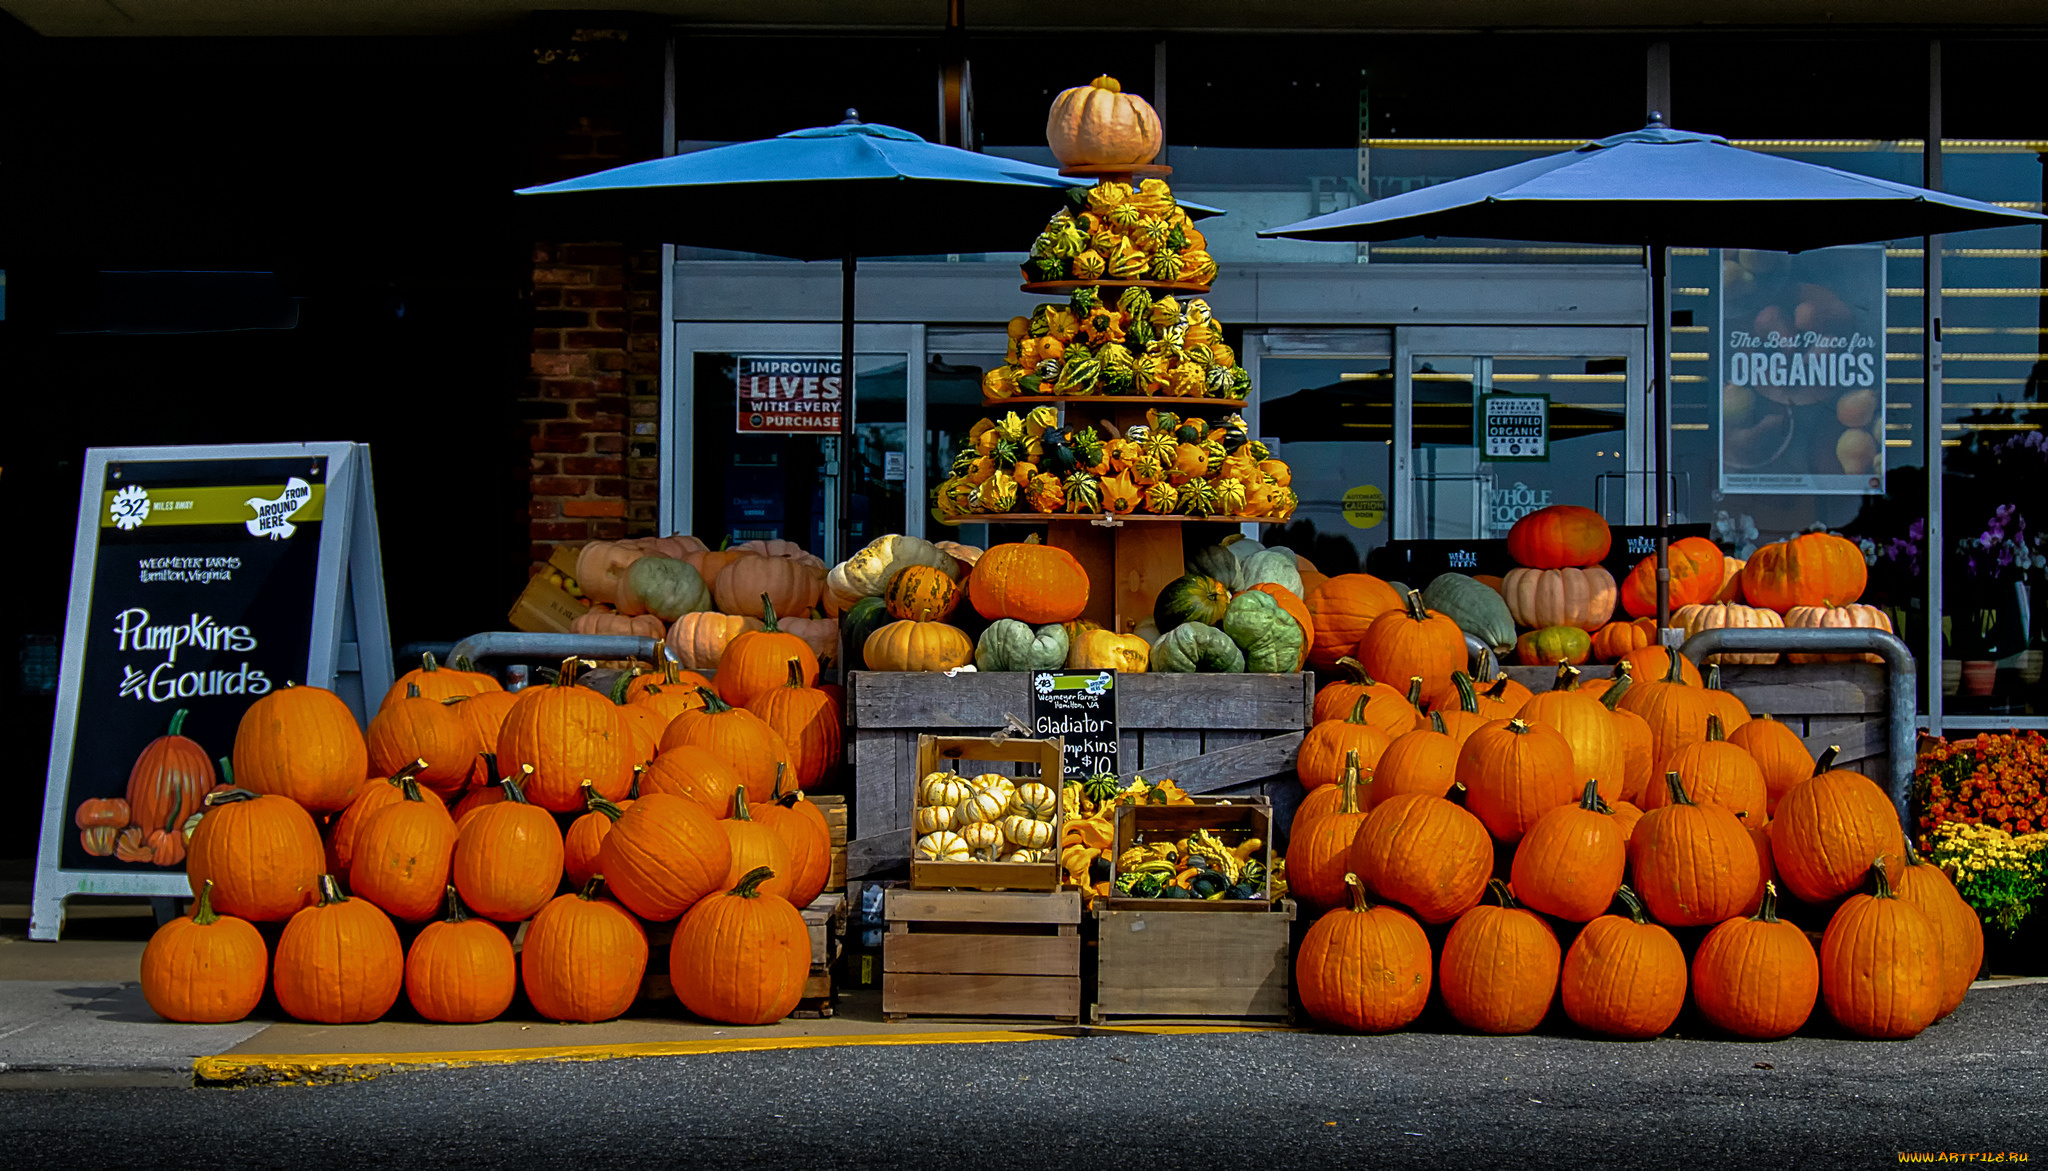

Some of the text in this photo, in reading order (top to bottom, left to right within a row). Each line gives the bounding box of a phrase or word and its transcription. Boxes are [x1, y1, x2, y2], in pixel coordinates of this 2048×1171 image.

[1730, 331, 1876, 353] The Best Place for
[751, 362, 841, 374] IMPROVING
[1731, 352, 1874, 387] ORGANICS
[750, 376, 841, 399] LIVES
[751, 402, 789, 412] WITH
[767, 416, 839, 426] PURCHASE
[1490, 417, 1541, 425] CERTIFIED
[1490, 427, 1540, 436] ORGANIC
[286, 486, 308, 500] FROM
[1489, 482, 1552, 505] WHOLE
[118, 498, 194, 517] 32 MILES AWAY
[259, 500, 298, 518] AROUND
[1344, 501, 1384, 510] CAUTION
[1490, 505, 1548, 522] FOO
[259, 514, 284, 530] HERE
[139, 556, 242, 569] WEGMEYER FARMS
[113, 607, 258, 662] Pumpkins
[147, 661, 272, 703] Gourds
[1077, 691, 1098, 701] Farms
[1037, 712, 1113, 734] Gladiator
[1049, 735, 1117, 758] mpkins
[1081, 755, 1111, 774] $10
